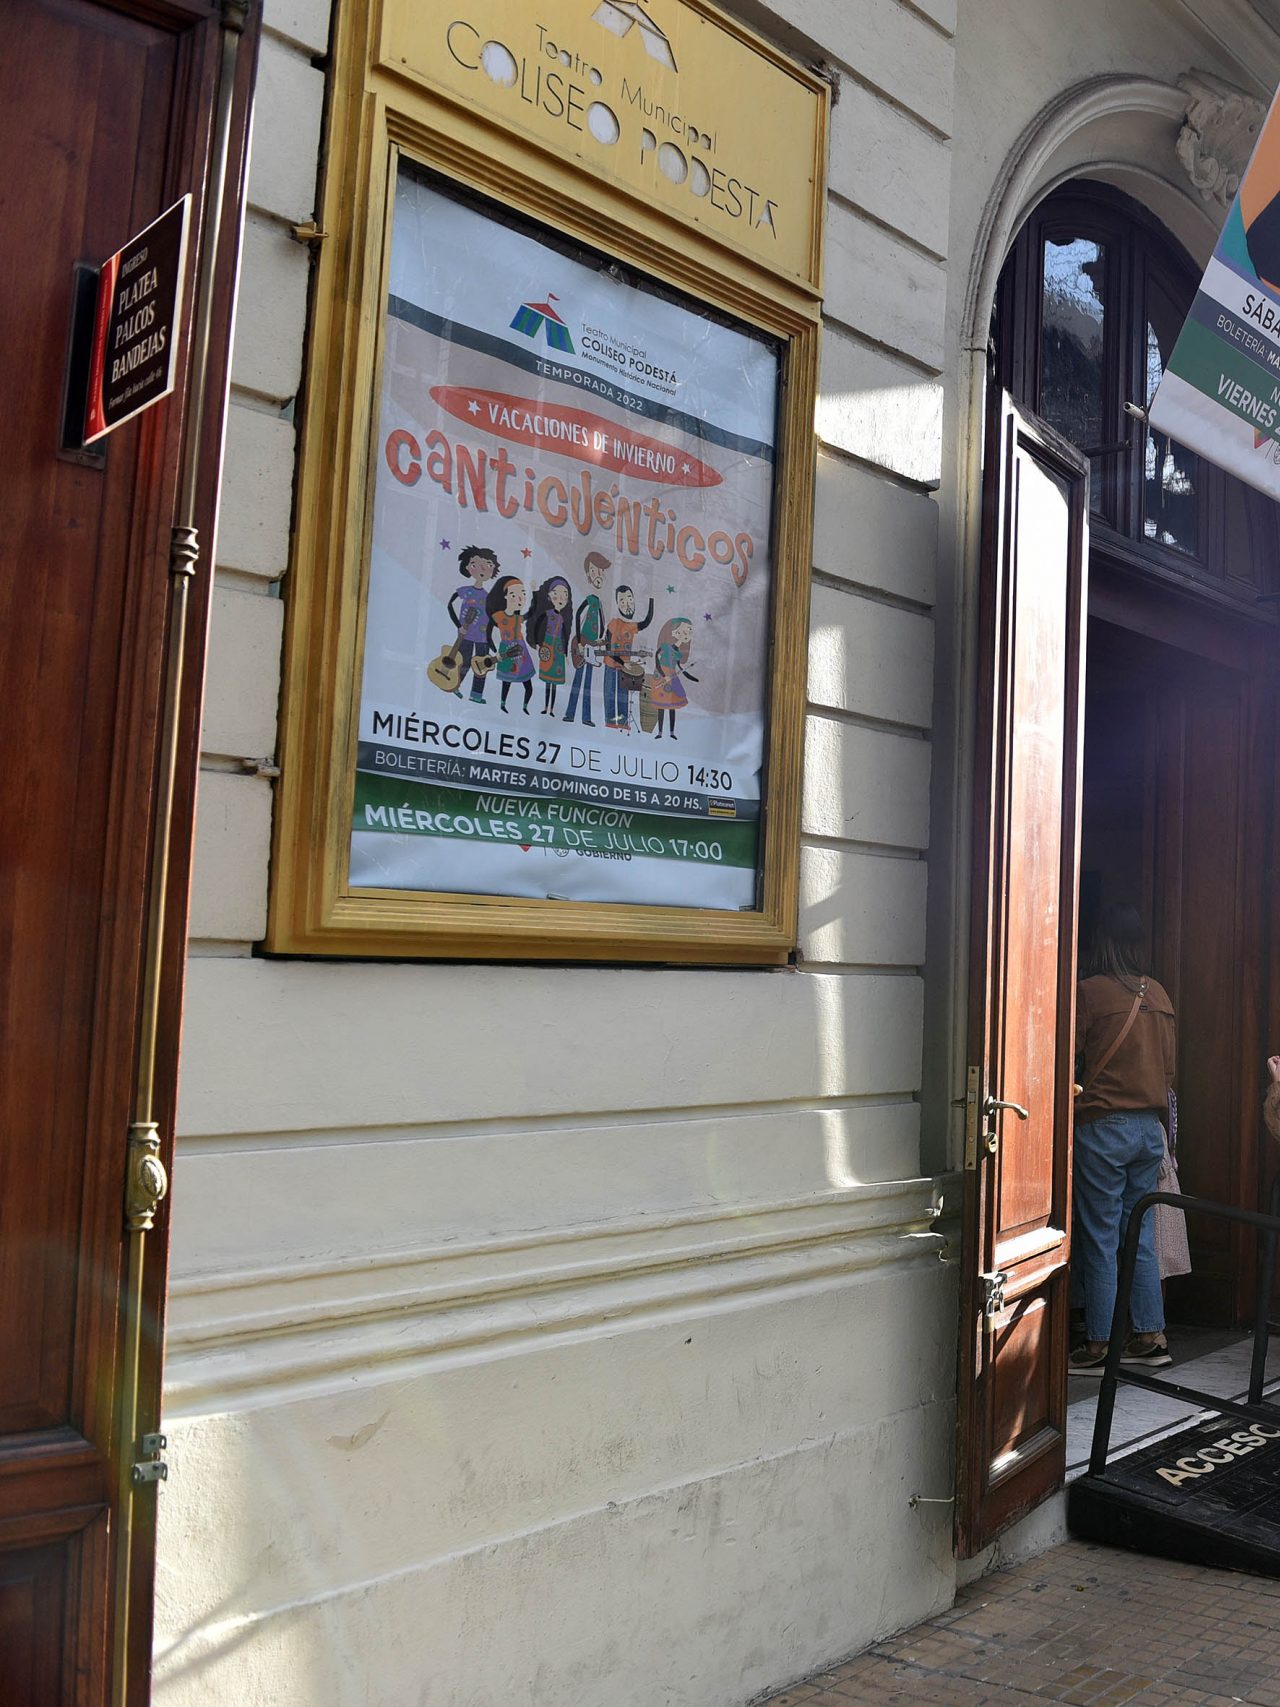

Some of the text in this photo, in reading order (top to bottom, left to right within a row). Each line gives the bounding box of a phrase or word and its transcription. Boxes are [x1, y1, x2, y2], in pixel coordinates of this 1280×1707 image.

[447, 21, 620, 145] COLISEO
[536, 24, 718, 154] Teatro Municipal
[121, 247, 149, 279] INGRESO
[117, 267, 158, 315] PLATEA
[113, 300, 156, 350] PALCOS
[582, 323, 647, 359] Teatro Municipal
[1216, 314, 1268, 358] BOLETERÍA:
[110, 326, 167, 384] BANDEJAS
[581, 336, 677, 384] COLISEO PODESTÁ
[581, 351, 618, 373] Monumento
[646, 379, 676, 396] Nacional
[535, 360, 644, 411] TEMPORADA 2022
[1217, 373, 1278, 428] VIERNES
[488, 402, 676, 474] VACACIONES DE INVIERNO
[372, 710, 732, 791] MIÉRCOLES 27 DE JULIO 14:30
[375, 750, 702, 810] BOLETERÍA: MARTES A DOMINGO DE 15 A 20 HS.
[364, 802, 722, 861] MIÉRCOLES 27 DE JULIO 17:00
[475, 795, 634, 829] NUEVA FUNCIÓN
